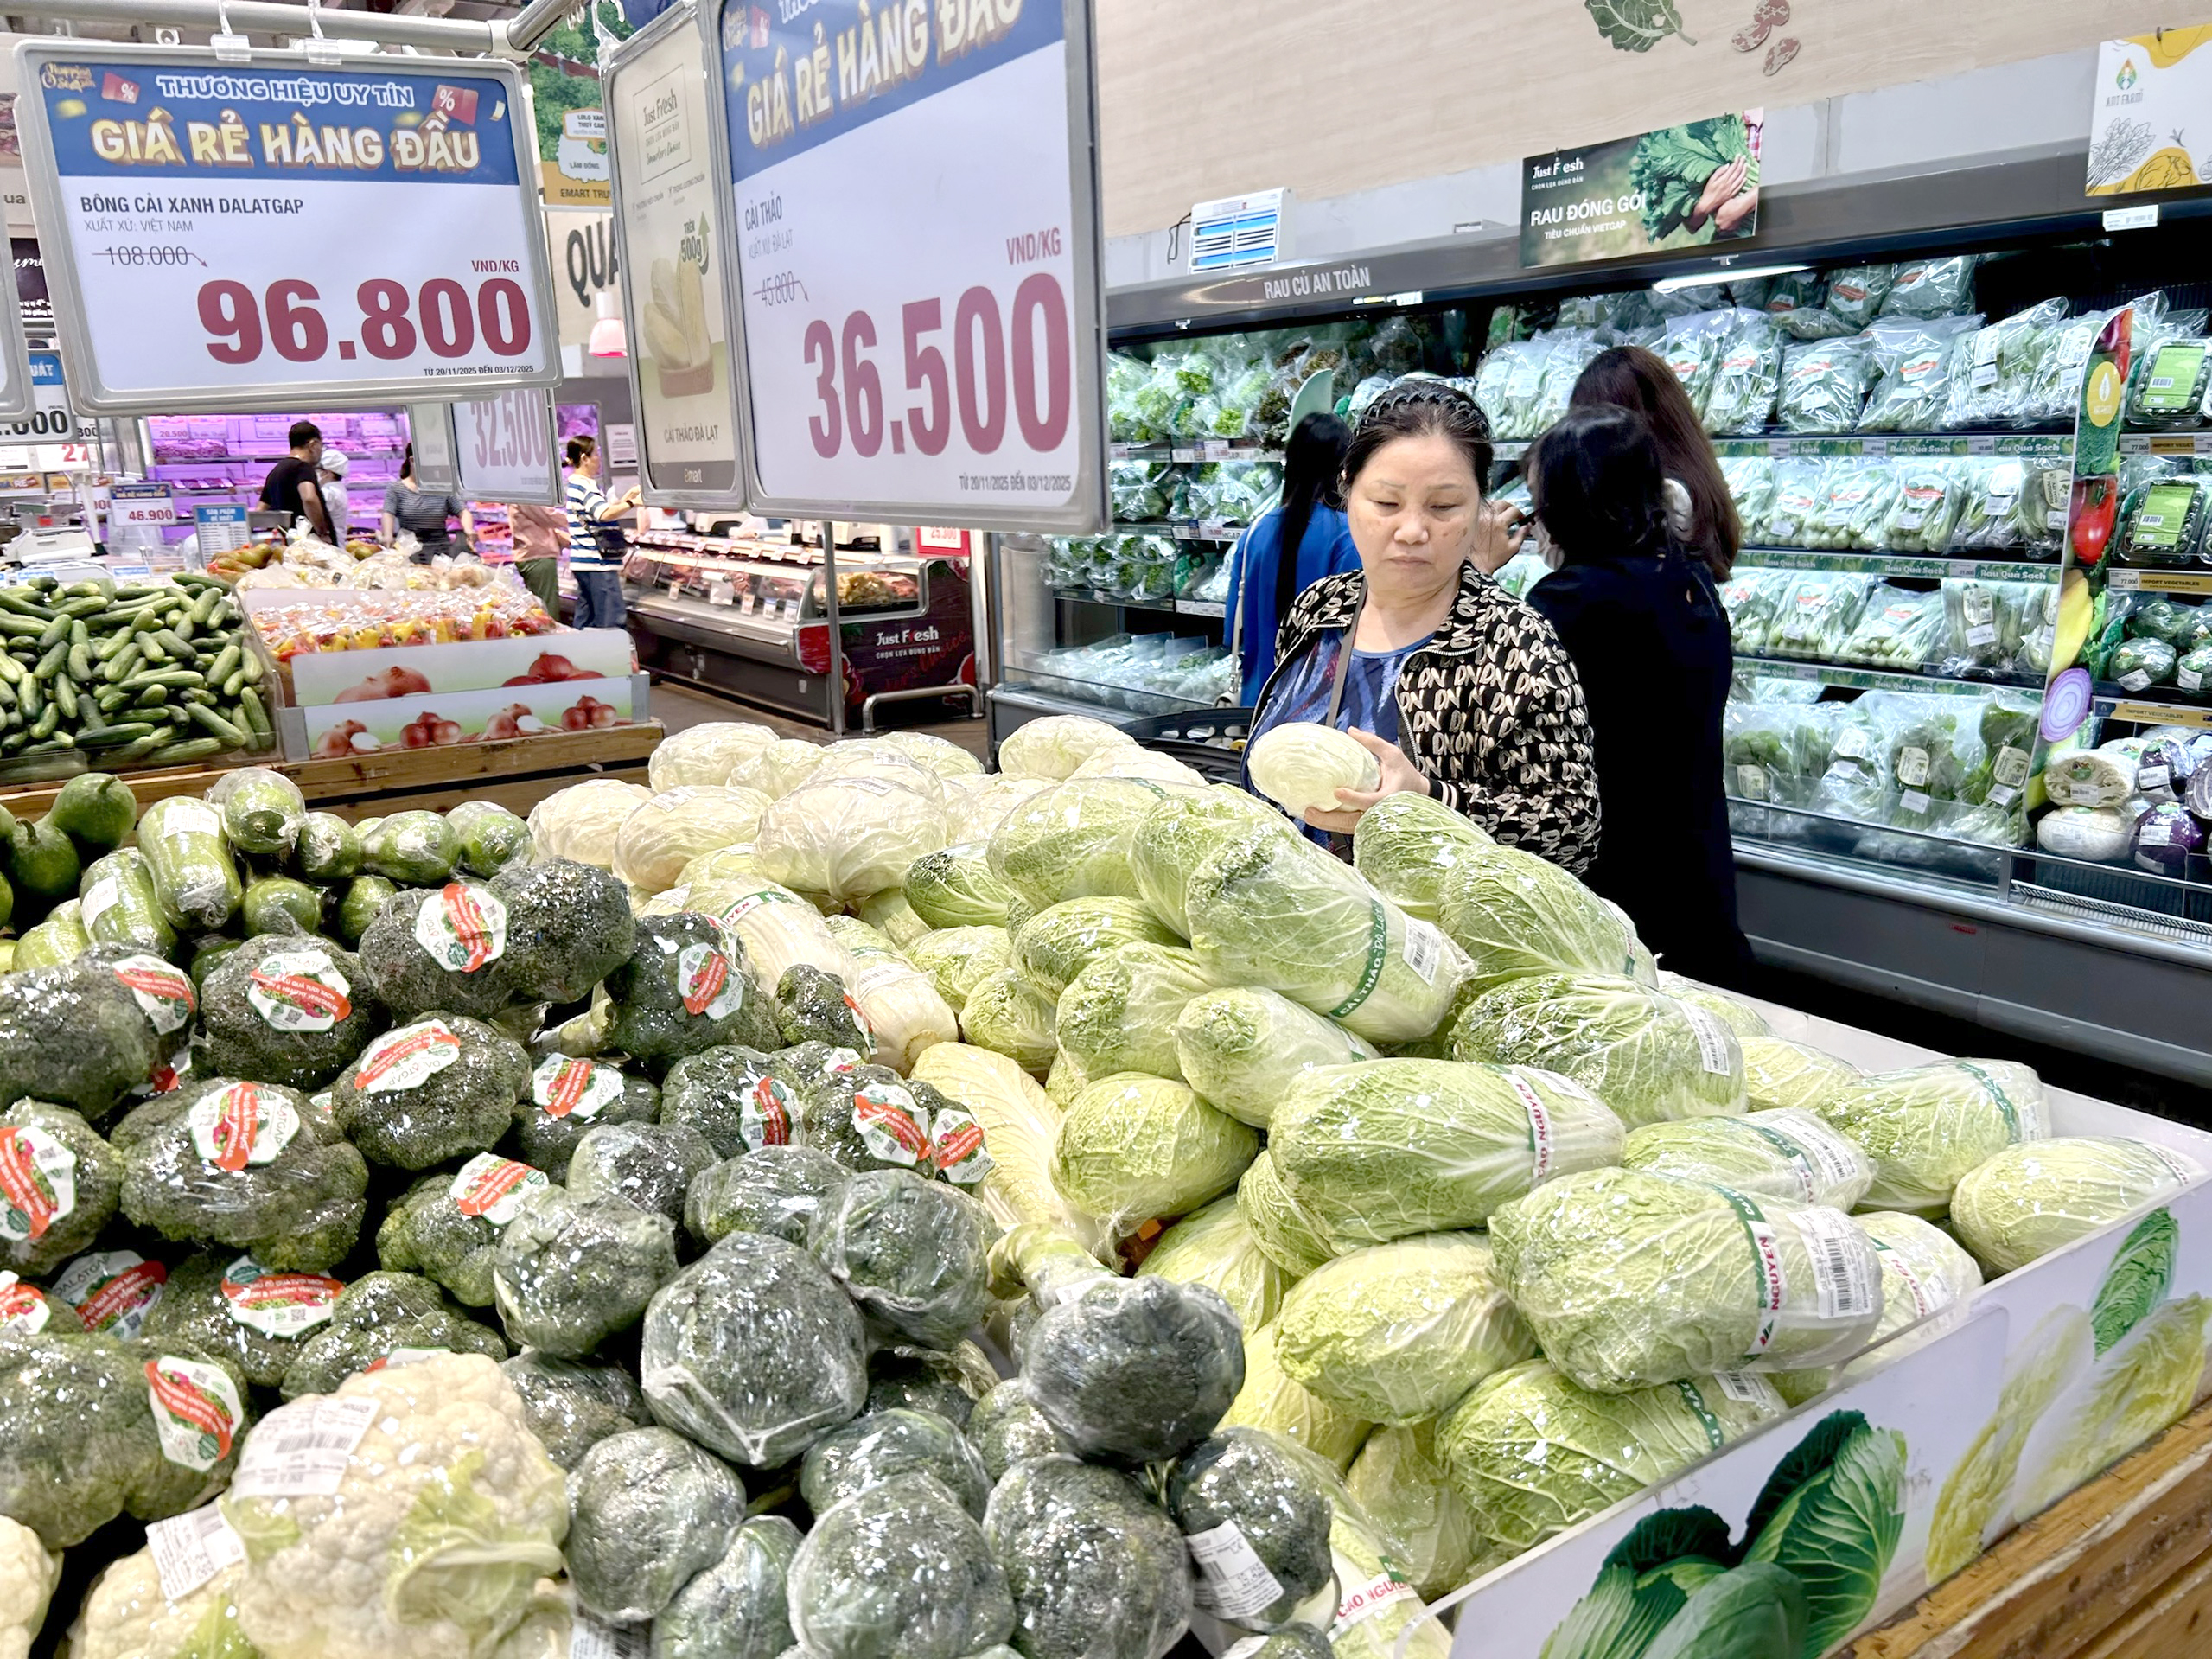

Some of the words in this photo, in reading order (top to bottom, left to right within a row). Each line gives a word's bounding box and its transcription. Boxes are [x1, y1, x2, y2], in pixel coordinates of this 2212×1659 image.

[747, 45, 794, 148] GIÁ
[794, 21, 833, 125] RẺ
[837, 0, 928, 103] HÀNG
[156, 74, 270, 101] THƯƠNG
[271, 77, 332, 107] HIỆU
[334, 83, 372, 105] UY
[372, 82, 415, 107] TÍN
[91, 106, 183, 164] GIÁ
[188, 109, 252, 166] RẺ
[261, 112, 383, 169] HÀNG
[393, 111, 479, 171] ĐẦU
[1533, 164, 1552, 179] Just
[80, 194, 129, 214] BÔNG
[135, 193, 163, 214] CẢI
[169, 197, 214, 214] XANH
[220, 197, 303, 214] DALATGAP
[560, 189, 590, 198] EMART
[745, 200, 759, 231] CẢI
[760, 190, 782, 226] THẢO
[1531, 207, 1563, 227] RAU
[1566, 198, 1613, 221] ĐÓNG
[1617, 189, 1647, 213] GÓI
[85, 220, 112, 232] XUẤT
[141, 220, 163, 233] VIỆT
[167, 220, 193, 232] NAM
[1545, 229, 1563, 239] TIÊU
[1592, 220, 1627, 233] VIETGAP
[105, 246, 188, 265] 108.000
[681, 236, 702, 263] 500g
[1006, 228, 1061, 265] VND/KG
[472, 260, 519, 272] VND/KG
[762, 271, 794, 306] 45.800
[1264, 278, 1290, 299] RAU
[1292, 269, 1310, 296] CỦ
[1313, 271, 1331, 293] AN
[1333, 264, 1371, 290] TOÀN
[197, 278, 531, 364] 96.800
[424, 367, 434, 376] TỪ
[435, 367, 476, 376] 20/11/2025
[478, 365, 493, 374] ĐẾN
[494, 365, 533, 373] 03/12/2025
[804, 272, 1071, 458] 36.500
[470, 389, 549, 468] 32.500
[1890, 445, 1908, 454] Rau
[2035, 443, 2060, 455] Sạch
[959, 474, 969, 489] TỪ
[971, 476, 1010, 490] 20/11/2025
[129, 509, 172, 521] 46.900
[1980, 568, 1998, 577] Rau
[876, 632, 900, 647] Just
[1340, 998, 1361, 1014] CẢI
[1516, 1083, 1546, 1141] NGUYEN
[1758, 1236, 1781, 1311] NGUYEN
[1337, 1594, 1364, 1618] CAO
